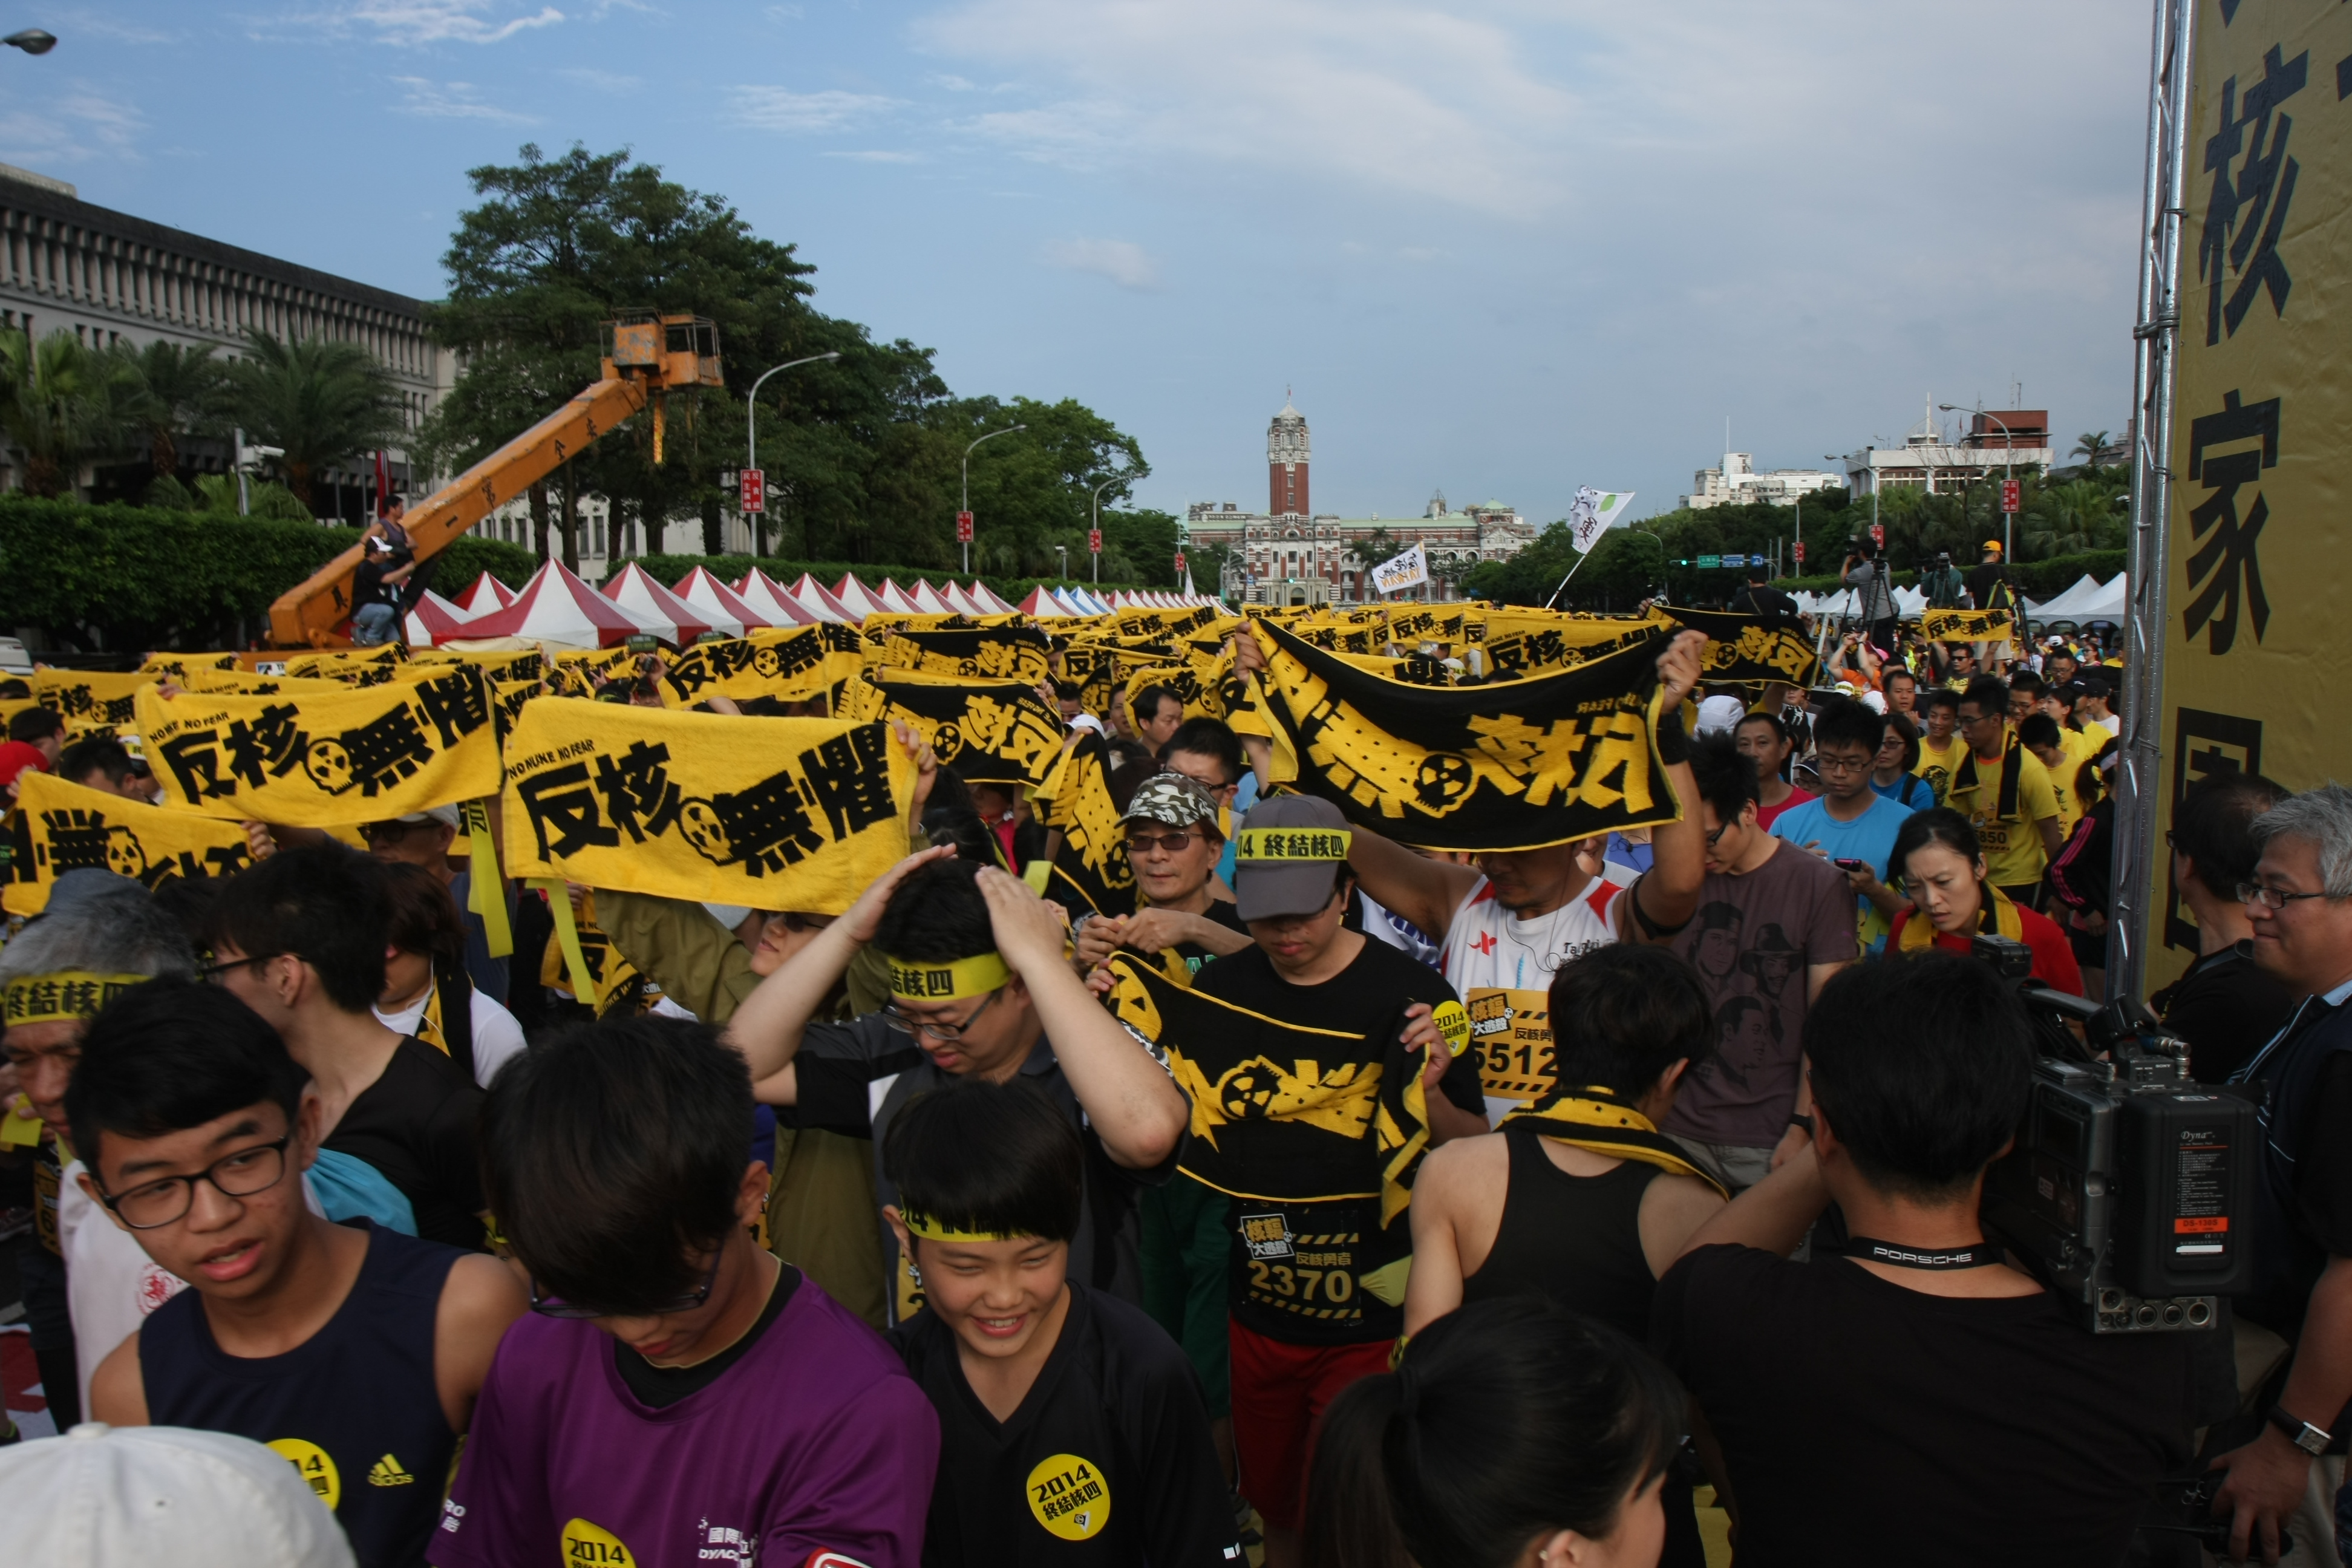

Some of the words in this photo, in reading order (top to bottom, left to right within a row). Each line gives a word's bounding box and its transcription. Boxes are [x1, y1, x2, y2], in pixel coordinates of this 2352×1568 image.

[149, 729, 166, 744] NO
[184, 719, 202, 730] NO
[203, 711, 230, 727] FEAR
[159, 668, 489, 805] 反核無懼
[509, 763, 524, 779] NO
[524, 751, 555, 771] NUKE
[558, 746, 572, 759] NO
[571, 739, 595, 755] FEAR
[517, 723, 898, 878] 反核無懼
[1264, 834, 1344, 857] 終結核四
[1433, 1011, 1465, 1029] 2014
[1471, 995, 1506, 1022] 核輻
[1474, 1018, 1508, 1037] 大逃殺
[2181, 1131, 2207, 1142] Dyna
[1246, 1217, 1285, 1243] 核輻
[1253, 1240, 1289, 1256] 大逃殺
[1295, 1252, 1353, 1267] 反核勇者
[1873, 1246, 1972, 1265] PORSCHE
[1247, 1259, 1354, 1303] 2370
[1031, 1463, 1092, 1503] 2014
[1042, 1480, 1103, 1521] 終結核四
[567, 1537, 626, 1564] 2014
